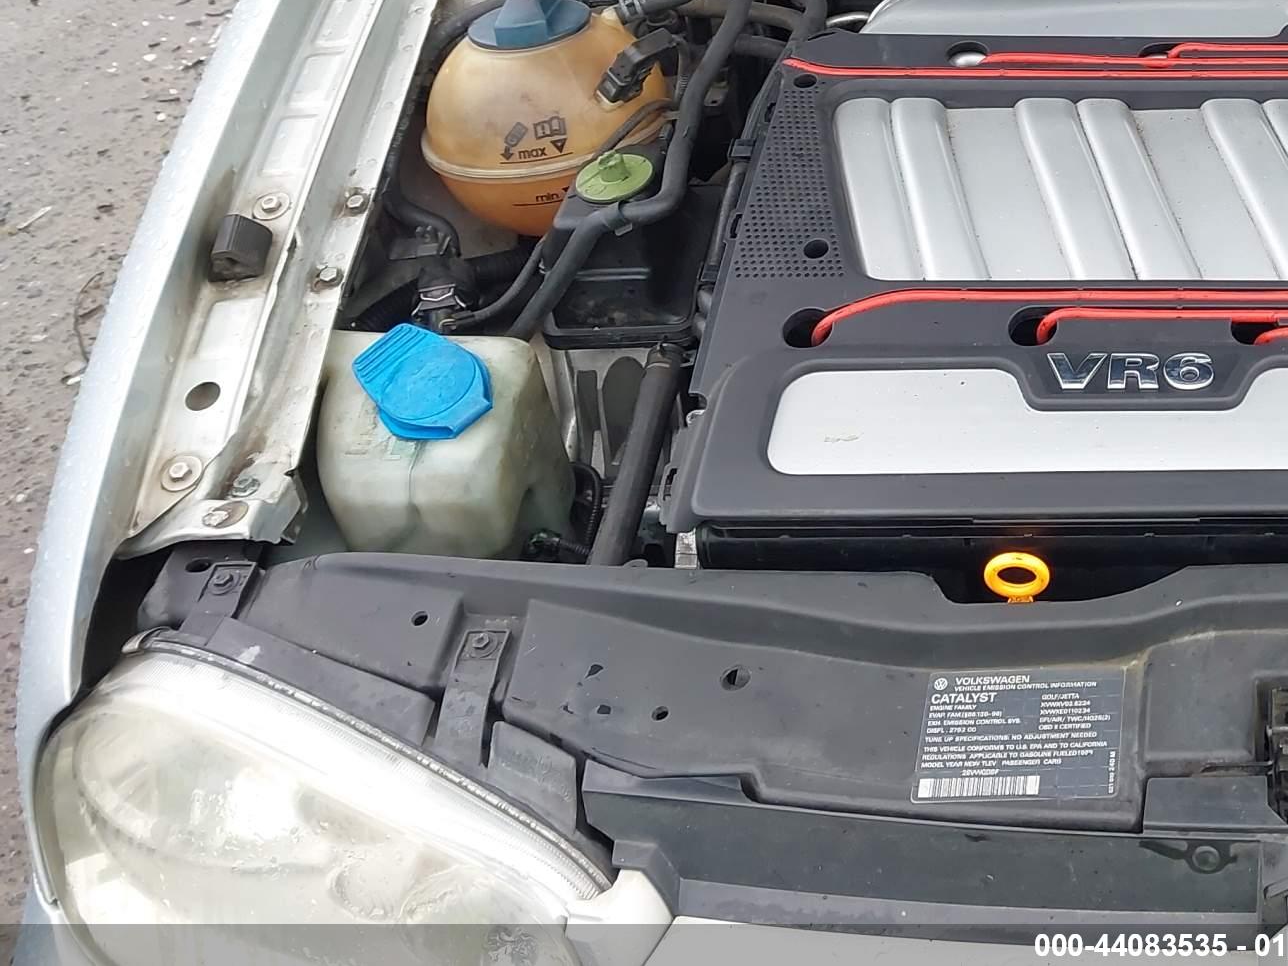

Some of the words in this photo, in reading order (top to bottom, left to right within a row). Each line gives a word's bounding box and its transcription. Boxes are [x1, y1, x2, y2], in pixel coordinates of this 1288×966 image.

[518, 147, 548, 160] max
[1046, 352, 1214, 390] VR6
[955, 675, 1030, 686] VOLKSWAGEN
[931, 692, 997, 704] CATALYST
